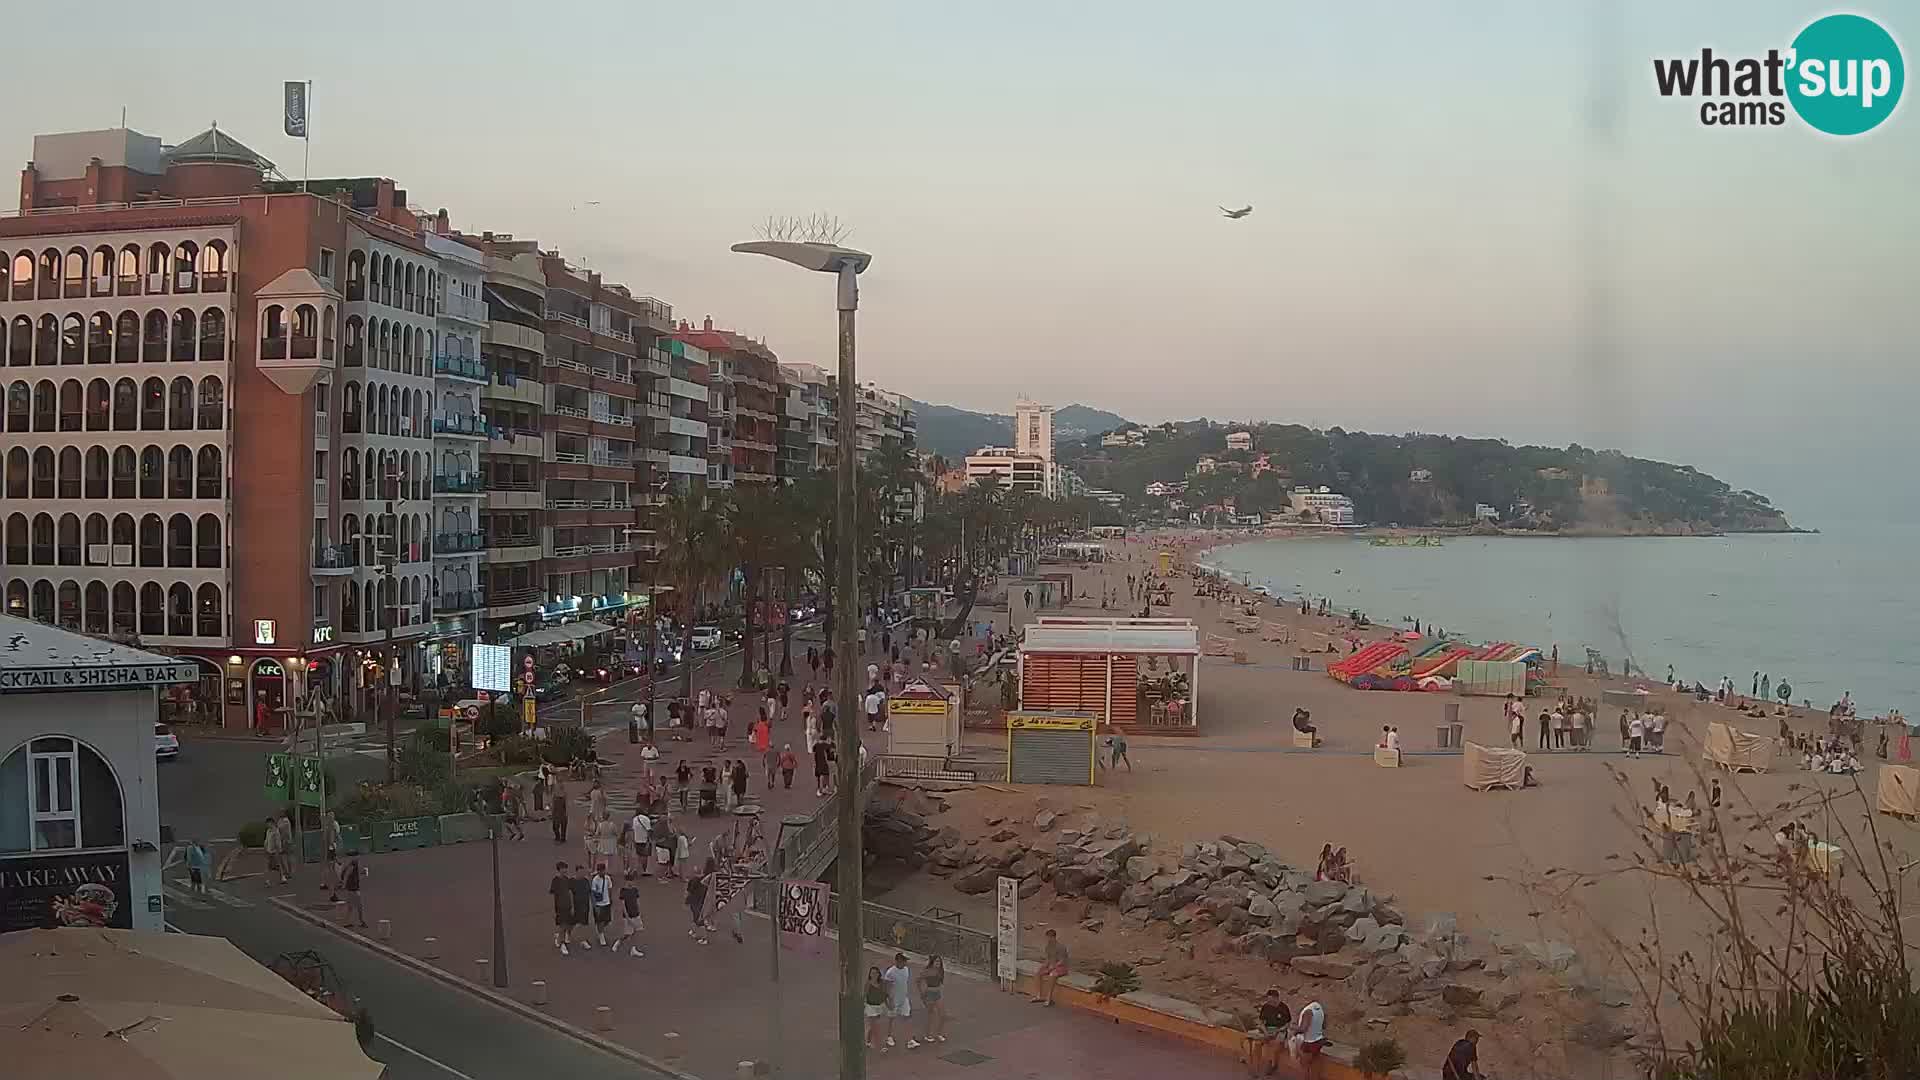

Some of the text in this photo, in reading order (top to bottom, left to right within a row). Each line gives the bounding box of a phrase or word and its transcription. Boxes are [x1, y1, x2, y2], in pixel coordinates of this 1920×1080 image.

[313, 626, 333, 644] KFC
[63, 671, 74, 685] &
[79, 669, 139, 684] SHISHA
[145, 667, 178, 681] BAR
[257, 665, 281, 675] KFC
